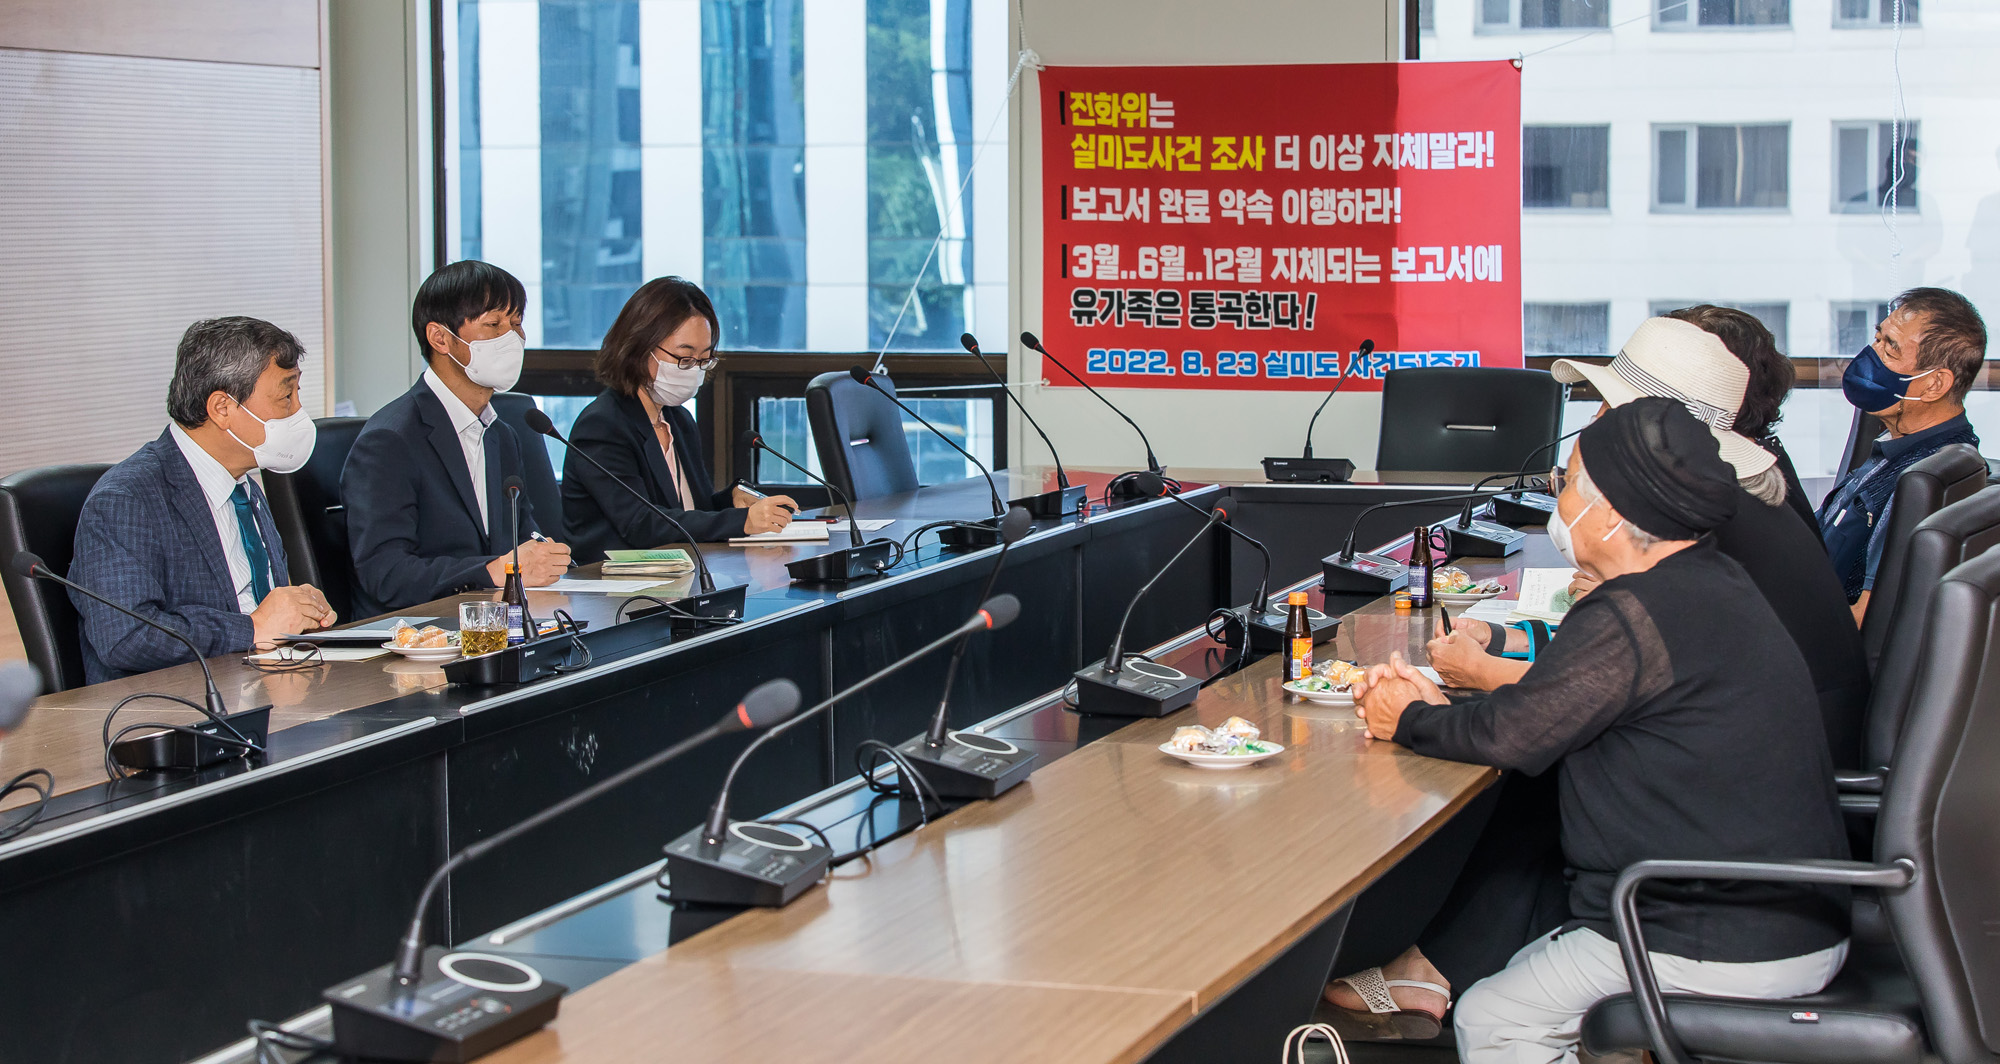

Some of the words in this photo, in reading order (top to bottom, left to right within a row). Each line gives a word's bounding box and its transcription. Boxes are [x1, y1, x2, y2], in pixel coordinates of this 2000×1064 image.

[1070, 92, 1174, 128] 진화위는
[1071, 134, 1201, 171] 실미도사건
[1211, 136, 1266, 171] 조사
[1275, 135, 1299, 171] 더
[1310, 134, 1365, 171] 이상
[1372, 131, 1494, 170] 지체말라!
[1072, 187, 1150, 223] 보고서
[1159, 188, 1210, 223] 완료
[1219, 189, 1273, 225] 약속
[1282, 187, 1401, 225] 이행하라!
[1072, 244, 1262, 283] 3월..6월..12월
[1271, 247, 1381, 283] 지체되는
[1390, 245, 1502, 283] 보고서에
[1071, 288, 1182, 326] 유가족은
[1190, 291, 1317, 330] 통곡한다!
[1087, 349, 1175, 375] 2022.
[1182, 351, 1210, 376] 8.
[1217, 352, 1258, 376] 23
[1264, 351, 1340, 378] 실미도
